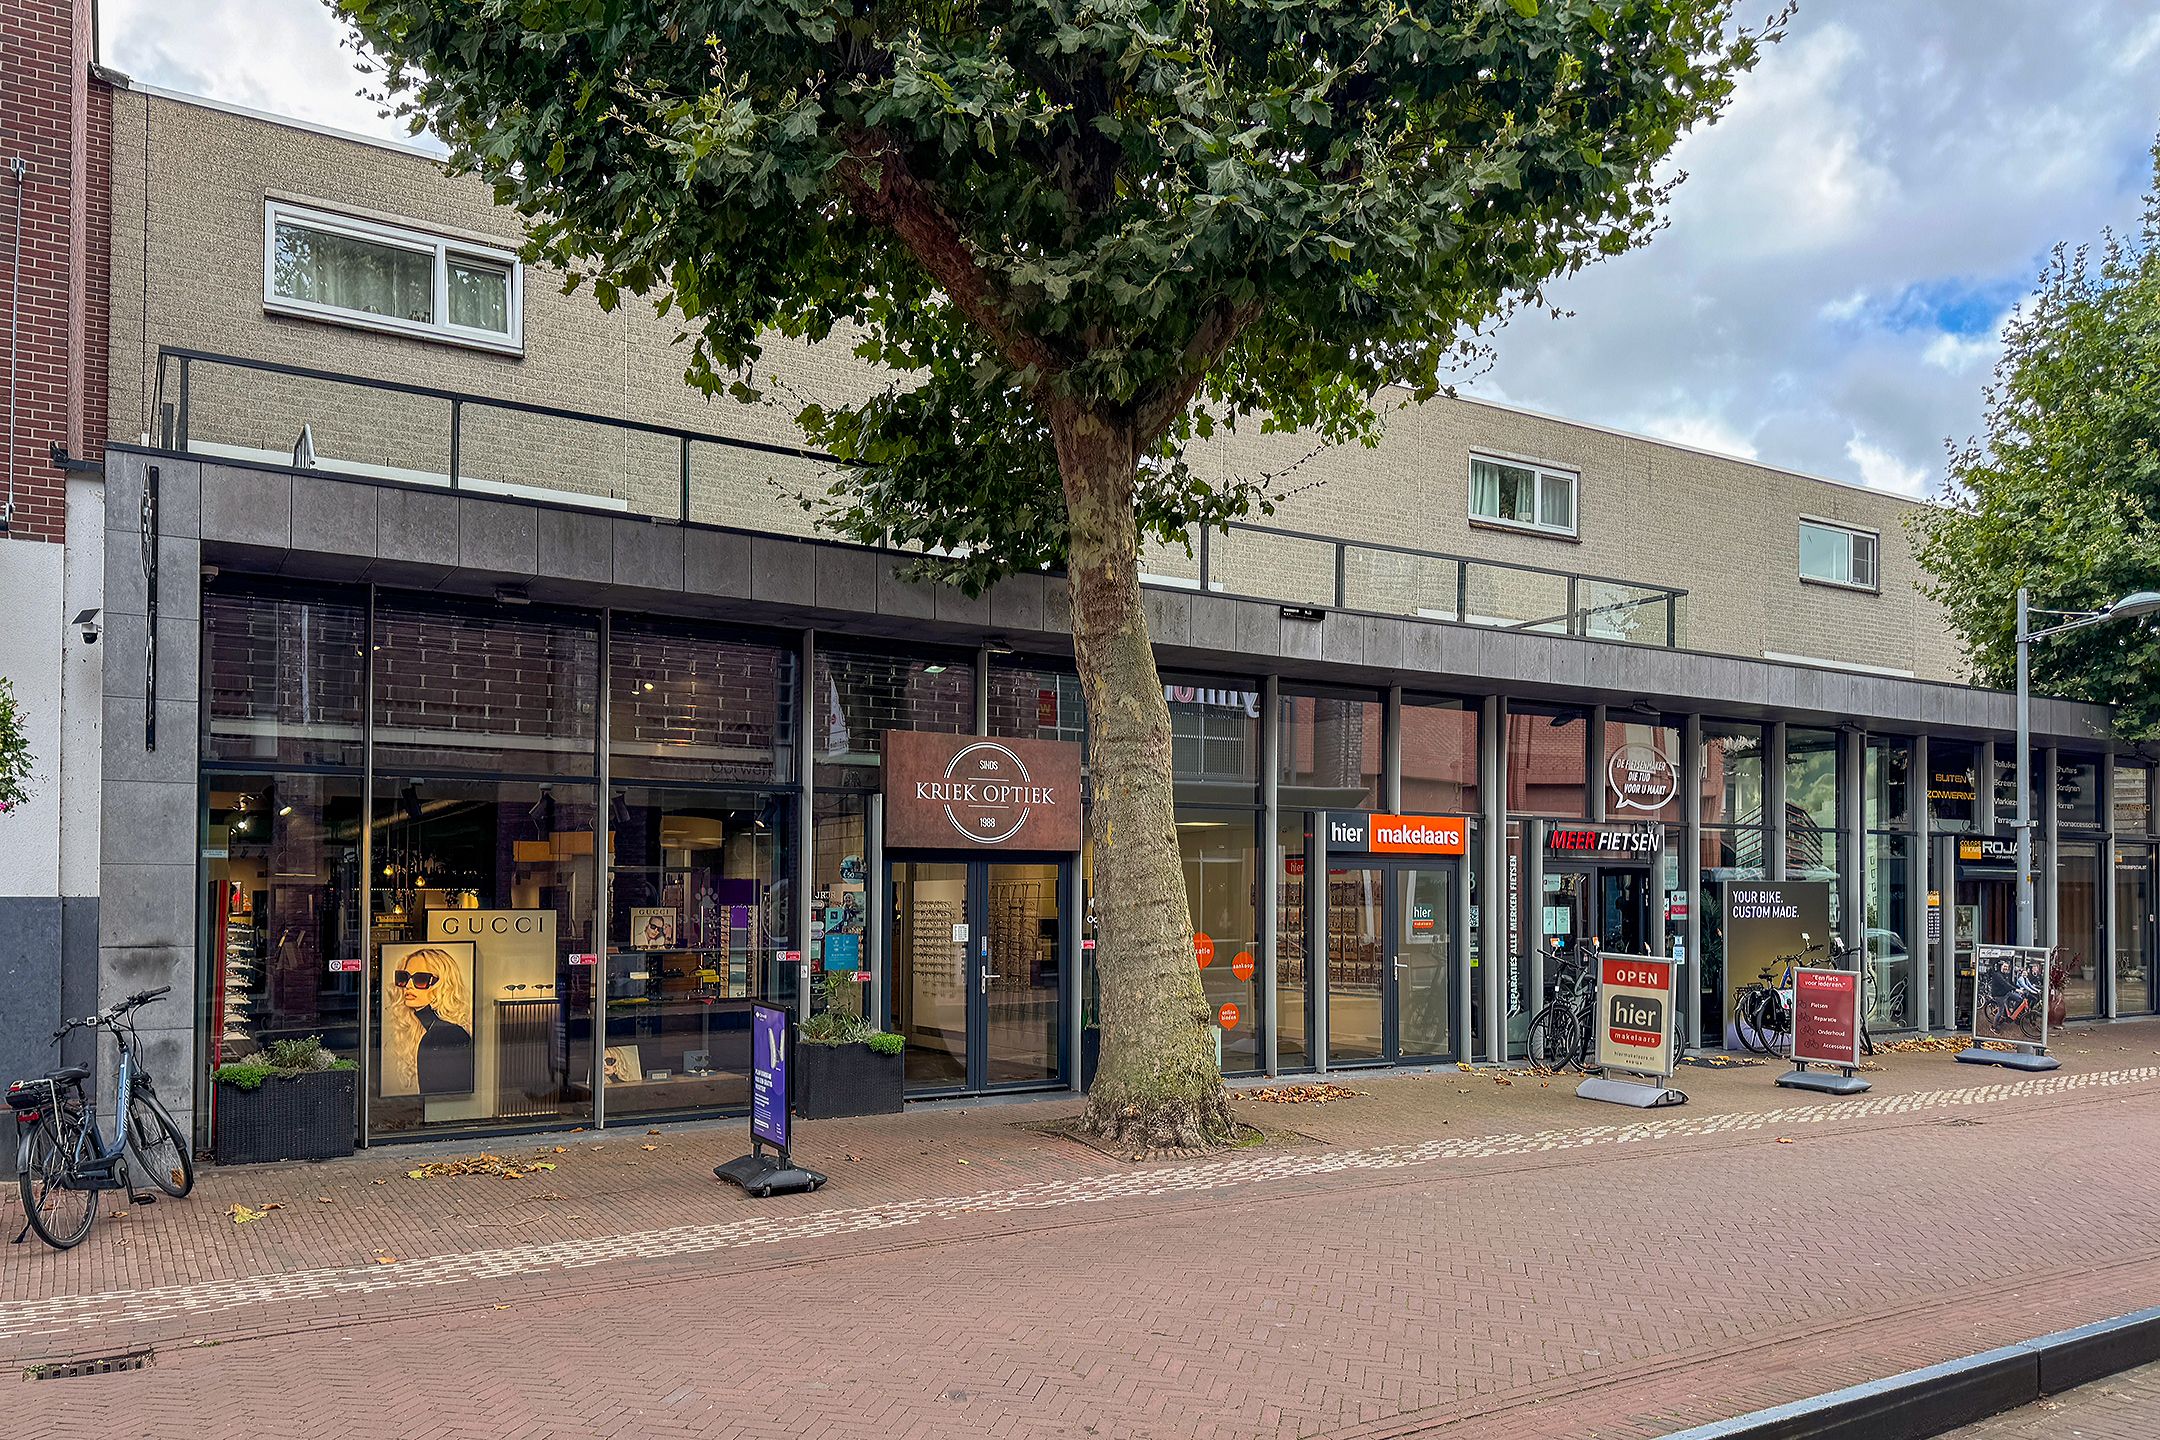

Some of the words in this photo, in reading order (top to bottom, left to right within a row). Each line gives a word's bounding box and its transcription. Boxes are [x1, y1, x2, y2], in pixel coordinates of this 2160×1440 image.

[979, 760, 998, 771] SINDS
[1616, 759, 1625, 769] DE
[1628, 772, 1638, 782] DIE
[1936, 774, 1966, 783] BUITEN
[916, 782, 977, 802] KRIEK
[983, 785, 1055, 805] OPTIEK
[1624, 784, 1640, 794] VOOR
[1641, 785, 1647, 794] U
[1647, 785, 1666, 795] MAAKT
[1927, 790, 1976, 800] ZONWERING
[980, 818, 996, 828] 1988
[1331, 821, 1363, 842] hier
[1377, 824, 1459, 845] makelaars
[1551, 830, 1596, 849] MEER
[1598, 832, 1660, 852] FIETSEN
[1290, 862, 1304, 872] hier
[1733, 891, 1758, 903] YOUR
[1760, 892, 1784, 904] BIKE.
[1414, 906, 1431, 918] hier
[1733, 906, 1770, 918] CUSTOM
[1773, 906, 1800, 918] MADE.
[441, 917, 543, 934] GUCCI
[1616, 969, 1658, 985] OPEN
[1510, 956, 1518, 1011] REPARATIES
[1615, 1000, 1656, 1027] hier
[1614, 1032, 1655, 1043] makelaars
[1817, 1029, 1845, 1037] Onderhoud
[1823, 1042, 1852, 1051] Accessoires
